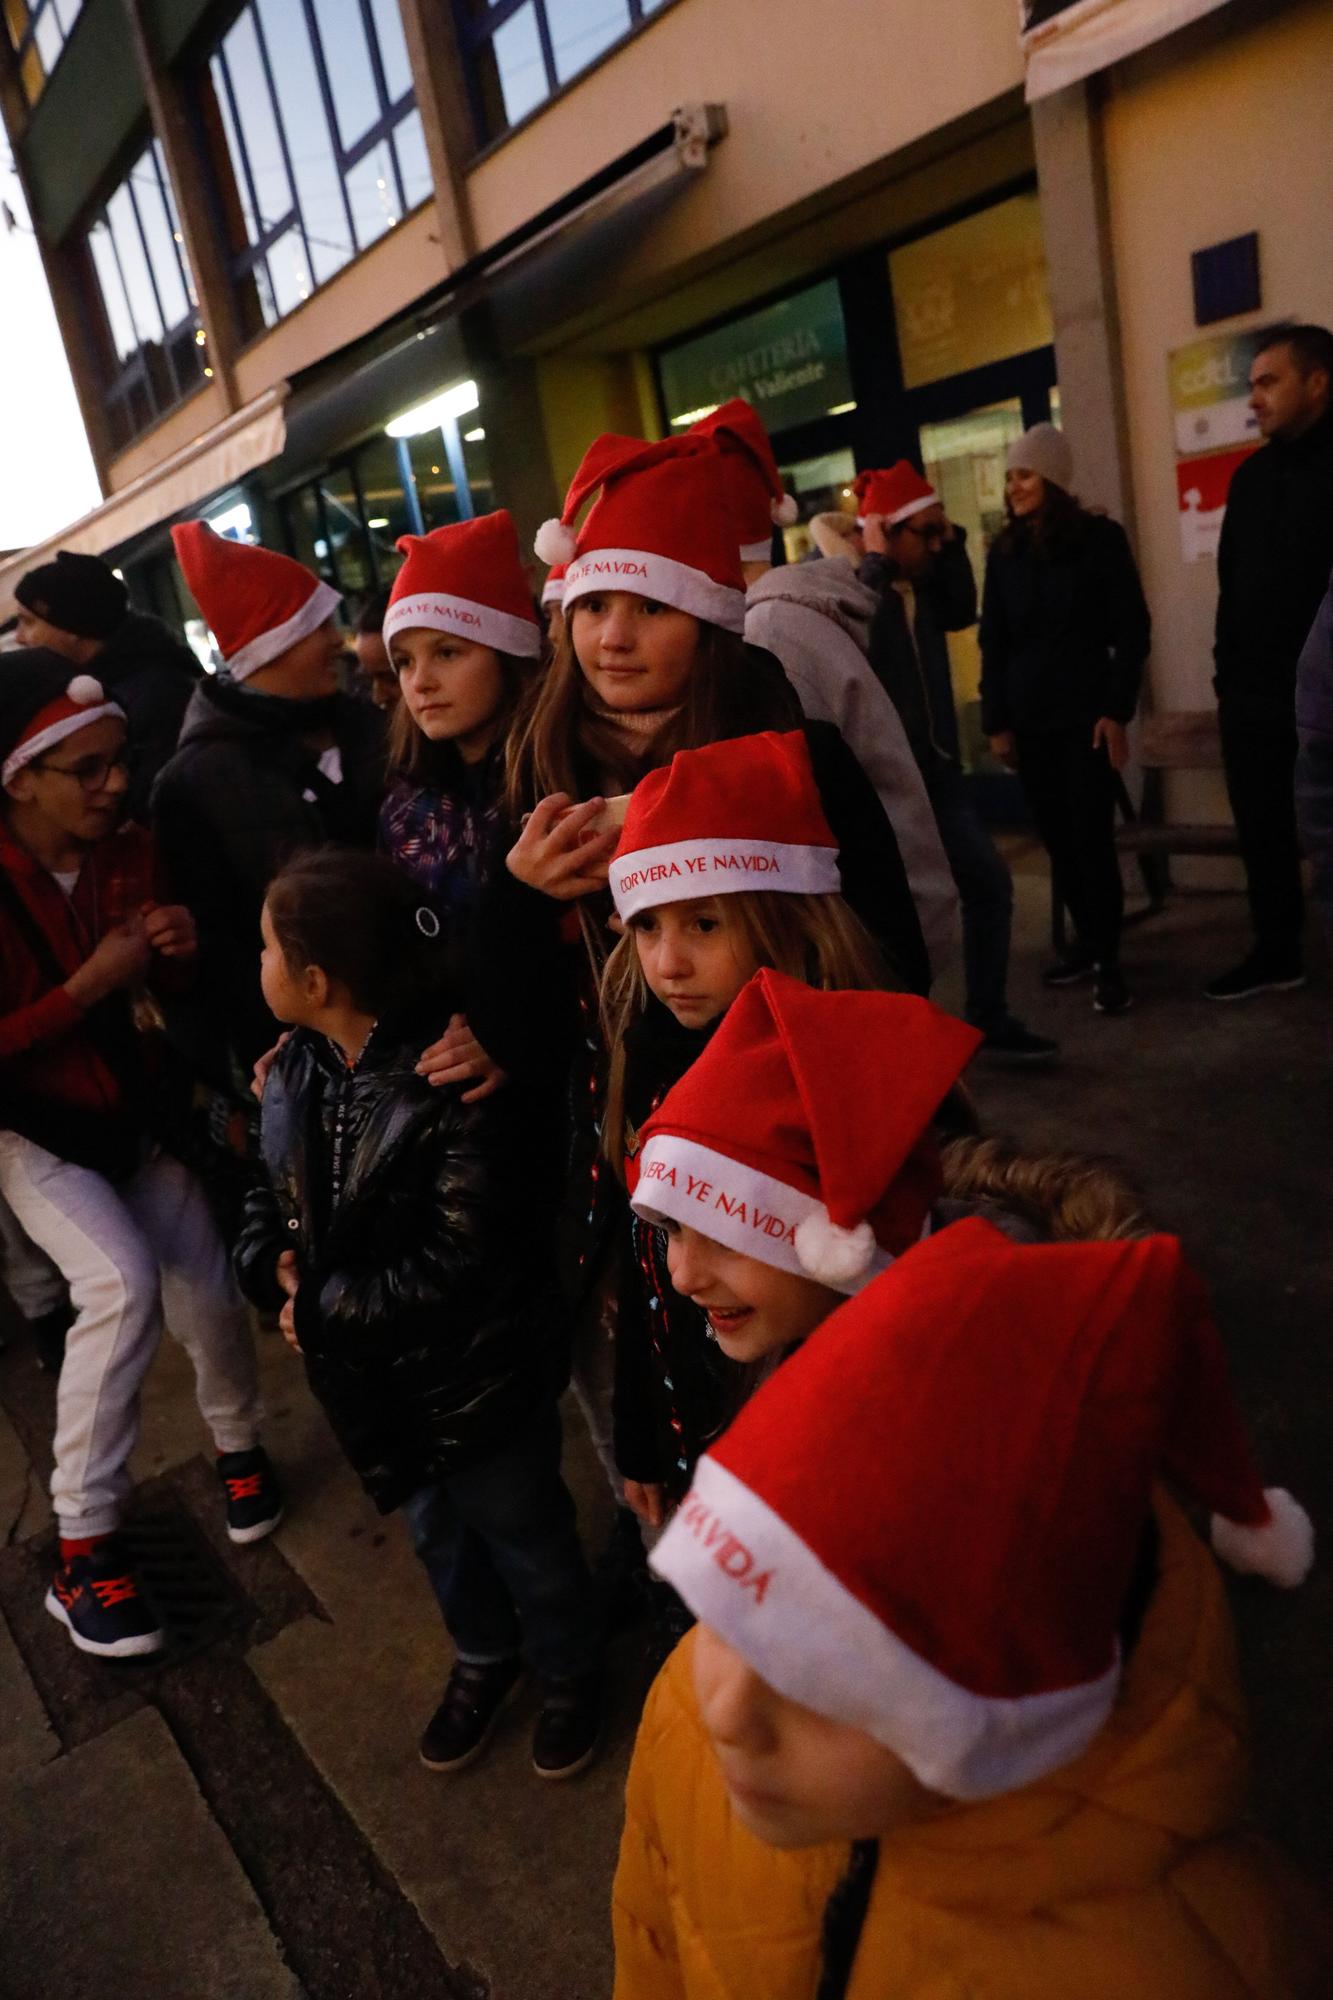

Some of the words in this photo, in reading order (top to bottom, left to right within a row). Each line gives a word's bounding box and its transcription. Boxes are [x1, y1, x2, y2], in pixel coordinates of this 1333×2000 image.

[416, 603, 430, 613] YE
[620, 861, 682, 894] CORVERA
[685, 857, 707, 873] YE
[714, 853, 781, 873] NAVIDÁ
[686, 1175, 713, 1203] YE
[714, 1192, 800, 1246] NAVIDÁ
